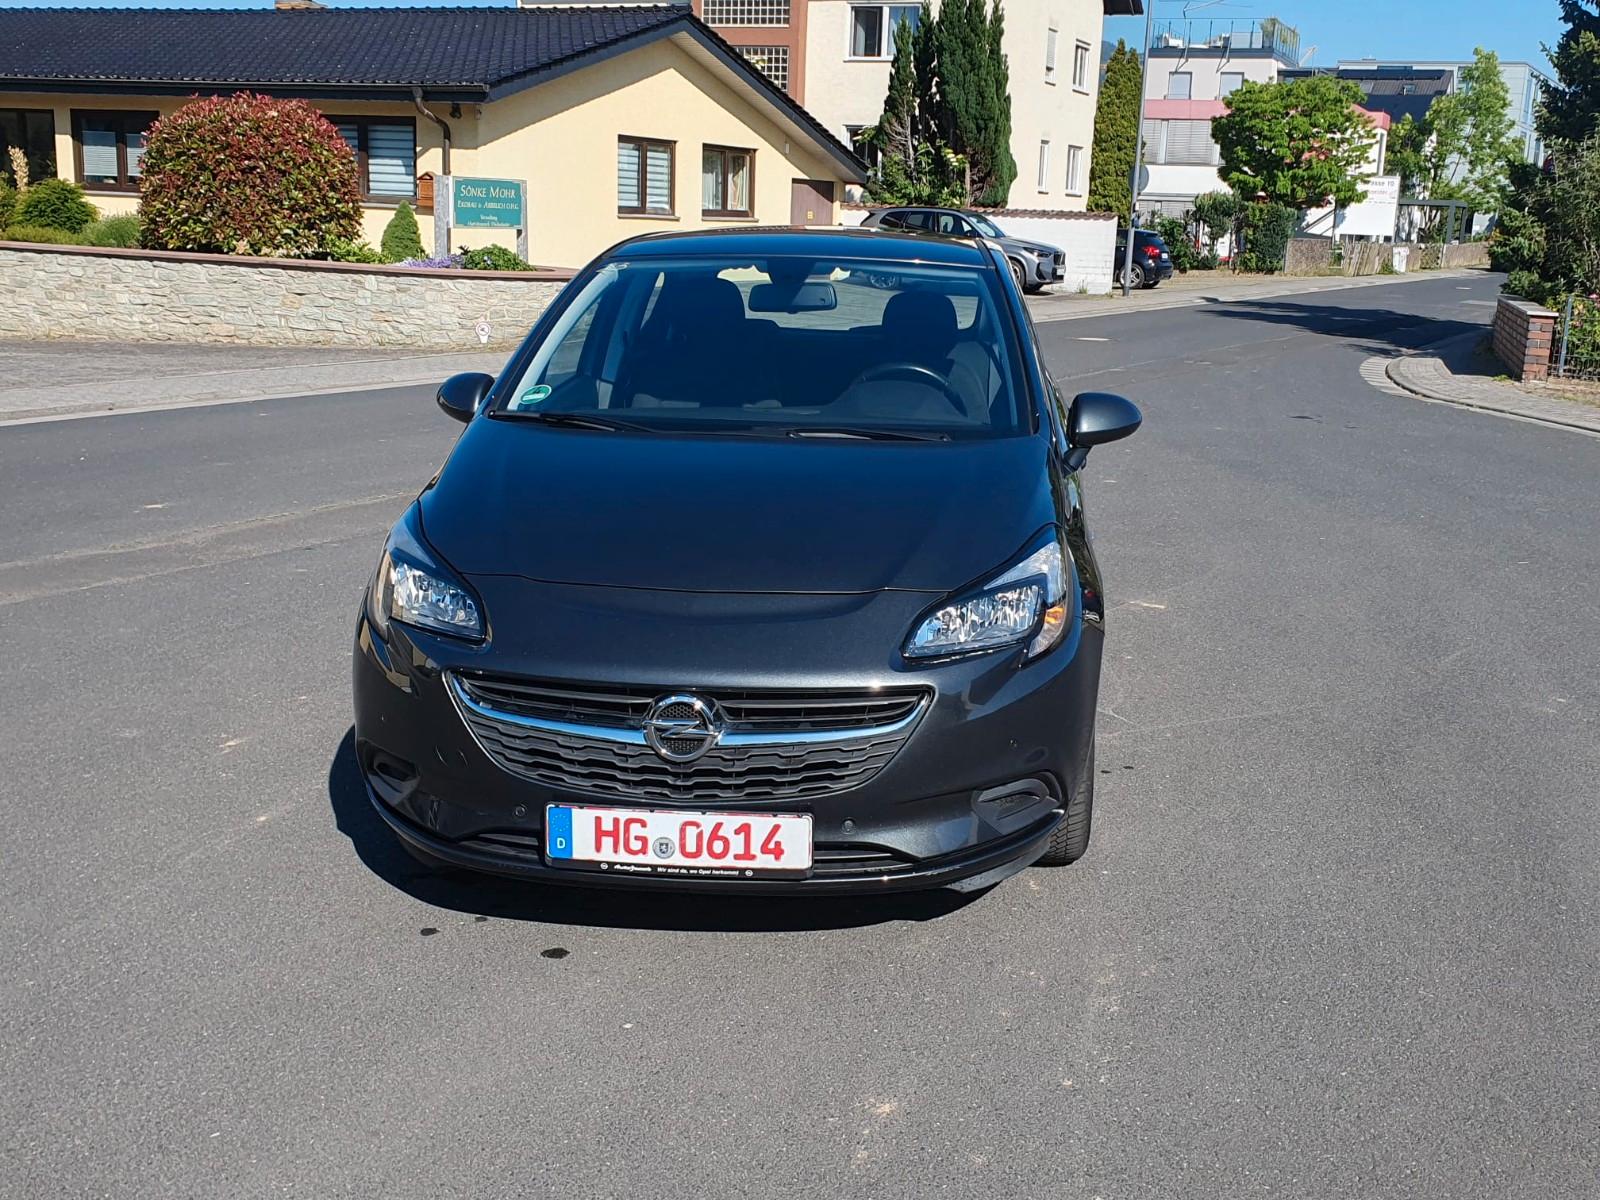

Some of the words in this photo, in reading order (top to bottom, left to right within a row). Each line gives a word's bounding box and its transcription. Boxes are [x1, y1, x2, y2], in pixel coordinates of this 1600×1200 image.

[489, 186, 516, 198] MOHR
[556, 837, 566, 849] D
[594, 815, 648, 856] HG
[678, 820, 785, 861] 0614
